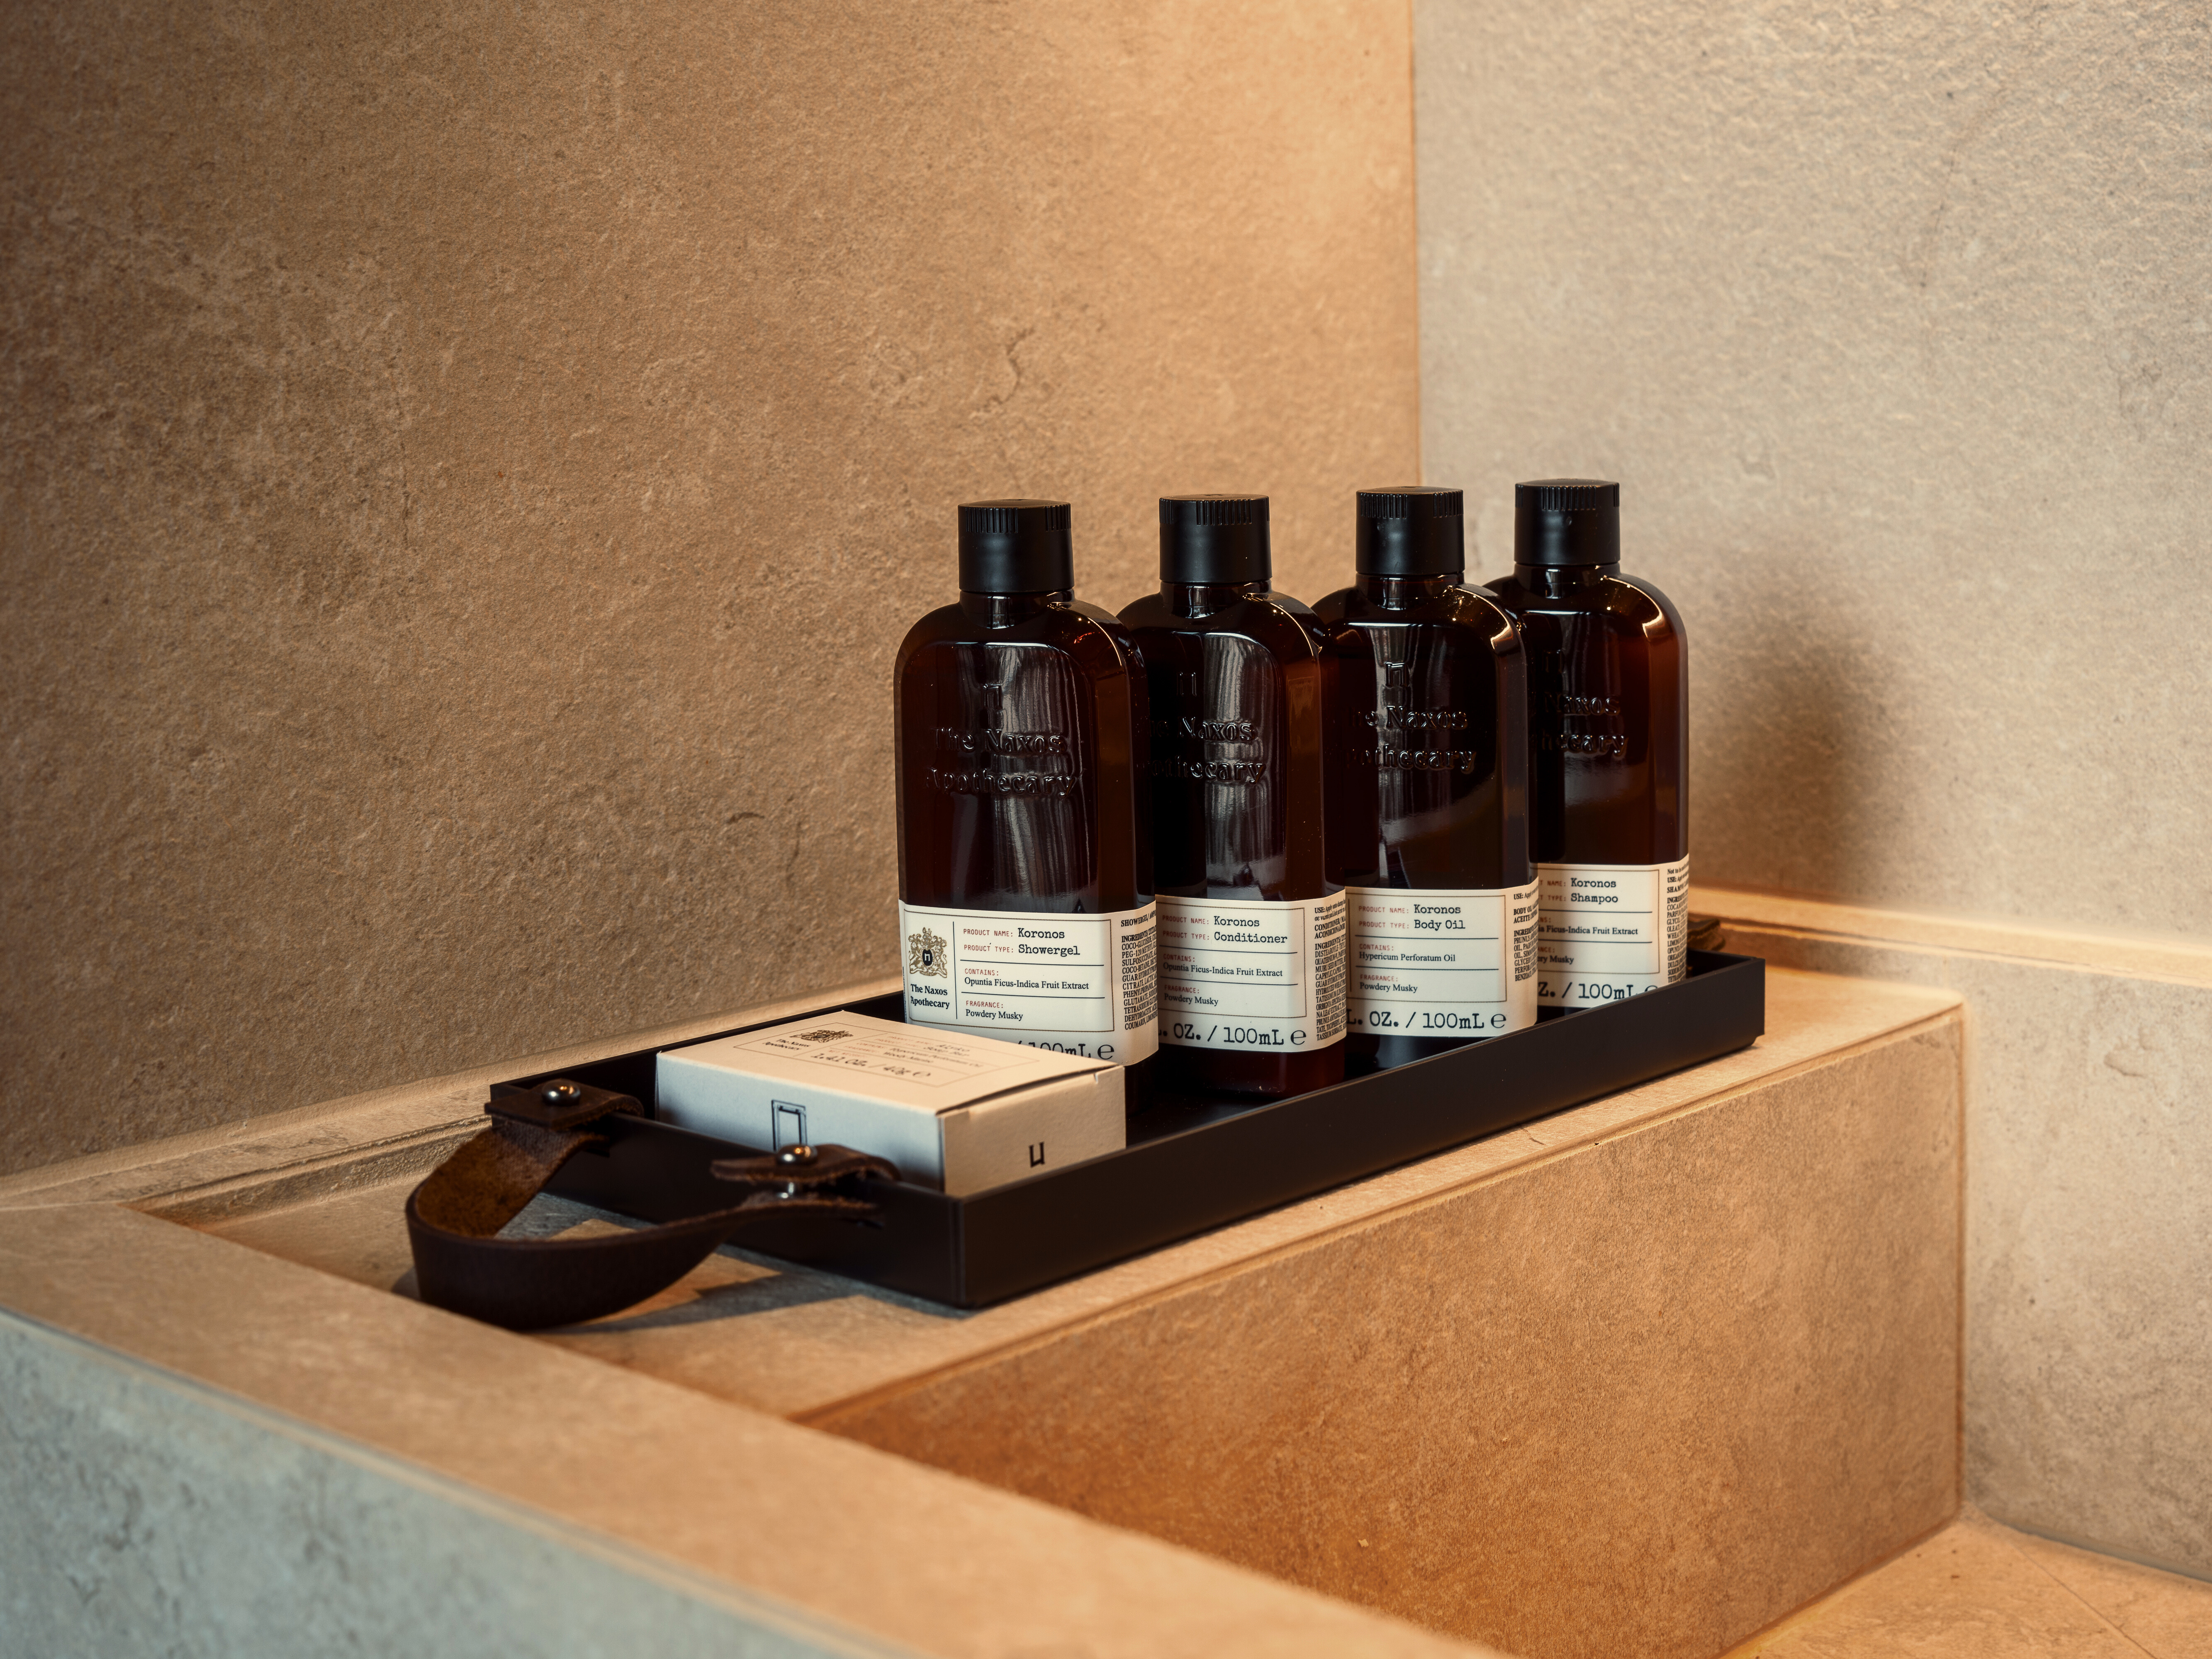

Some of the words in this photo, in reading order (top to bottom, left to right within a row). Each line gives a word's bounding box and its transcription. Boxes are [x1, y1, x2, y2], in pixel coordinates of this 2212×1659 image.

[1386, 705, 1468, 730] Naxos
[1176, 717, 1258, 741] Naxos
[930, 727, 976, 753] The
[983, 729, 1067, 754] Naxos
[925, 766, 1077, 798] Apothecary
[1570, 877, 1616, 888] Koronos
[1570, 893, 1618, 905] Shampoo
[1414, 904, 1461, 914] Koronos
[1162, 915, 1187, 924] PRODUCT
[1214, 916, 1260, 927] Koronos
[1414, 920, 1442, 931] Body
[1445, 920, 1466, 929] Oil
[1514, 915, 1530, 924] ACEITE
[1017, 927, 1065, 939] Koronos
[1315, 923, 1345, 939] ACONDICIONADOR
[1546, 925, 1590, 934] Ficus-Indica
[1162, 931, 1188, 939] PRODUCT
[1214, 932, 1287, 943] Conditioner
[1514, 935, 1530, 944] PRUNUS
[1018, 944, 1080, 957] Showergel
[1358, 951, 1398, 962] Hypericum
[1163, 954, 1195, 962] CONTAINS:
[1550, 955, 1574, 965] Musky
[1163, 962, 1189, 972] Opuntia
[1190, 965, 1234, 975] Ficus-Indica
[1315, 964, 1328, 973] MURU
[964, 977, 993, 987] Opuntia
[994, 979, 1039, 988] Ficus-Indica
[1359, 981, 1391, 991] Powdery
[1393, 984, 1418, 993] Musky
[910, 983, 923, 993] The
[925, 985, 948, 995] Naxos
[1164, 984, 1199, 994] FRAGRANCE:
[910, 995, 950, 1010] Apothecary
[1164, 993, 1193, 1005] Powdery
[1194, 996, 1219, 1007] Musky
[966, 1009, 996, 1020] Powdery
[998, 1011, 1023, 1022] Musky
[1317, 1017, 1329, 1026] PRUNUS
[1369, 1011, 1399, 1027] OZ.
[1423, 1013, 1484, 1029] 100mL
[1173, 1023, 1201, 1040] OZ.
[1223, 1027, 1284, 1046] 100mL
[1317, 1030, 1331, 1041] TASSIUM
